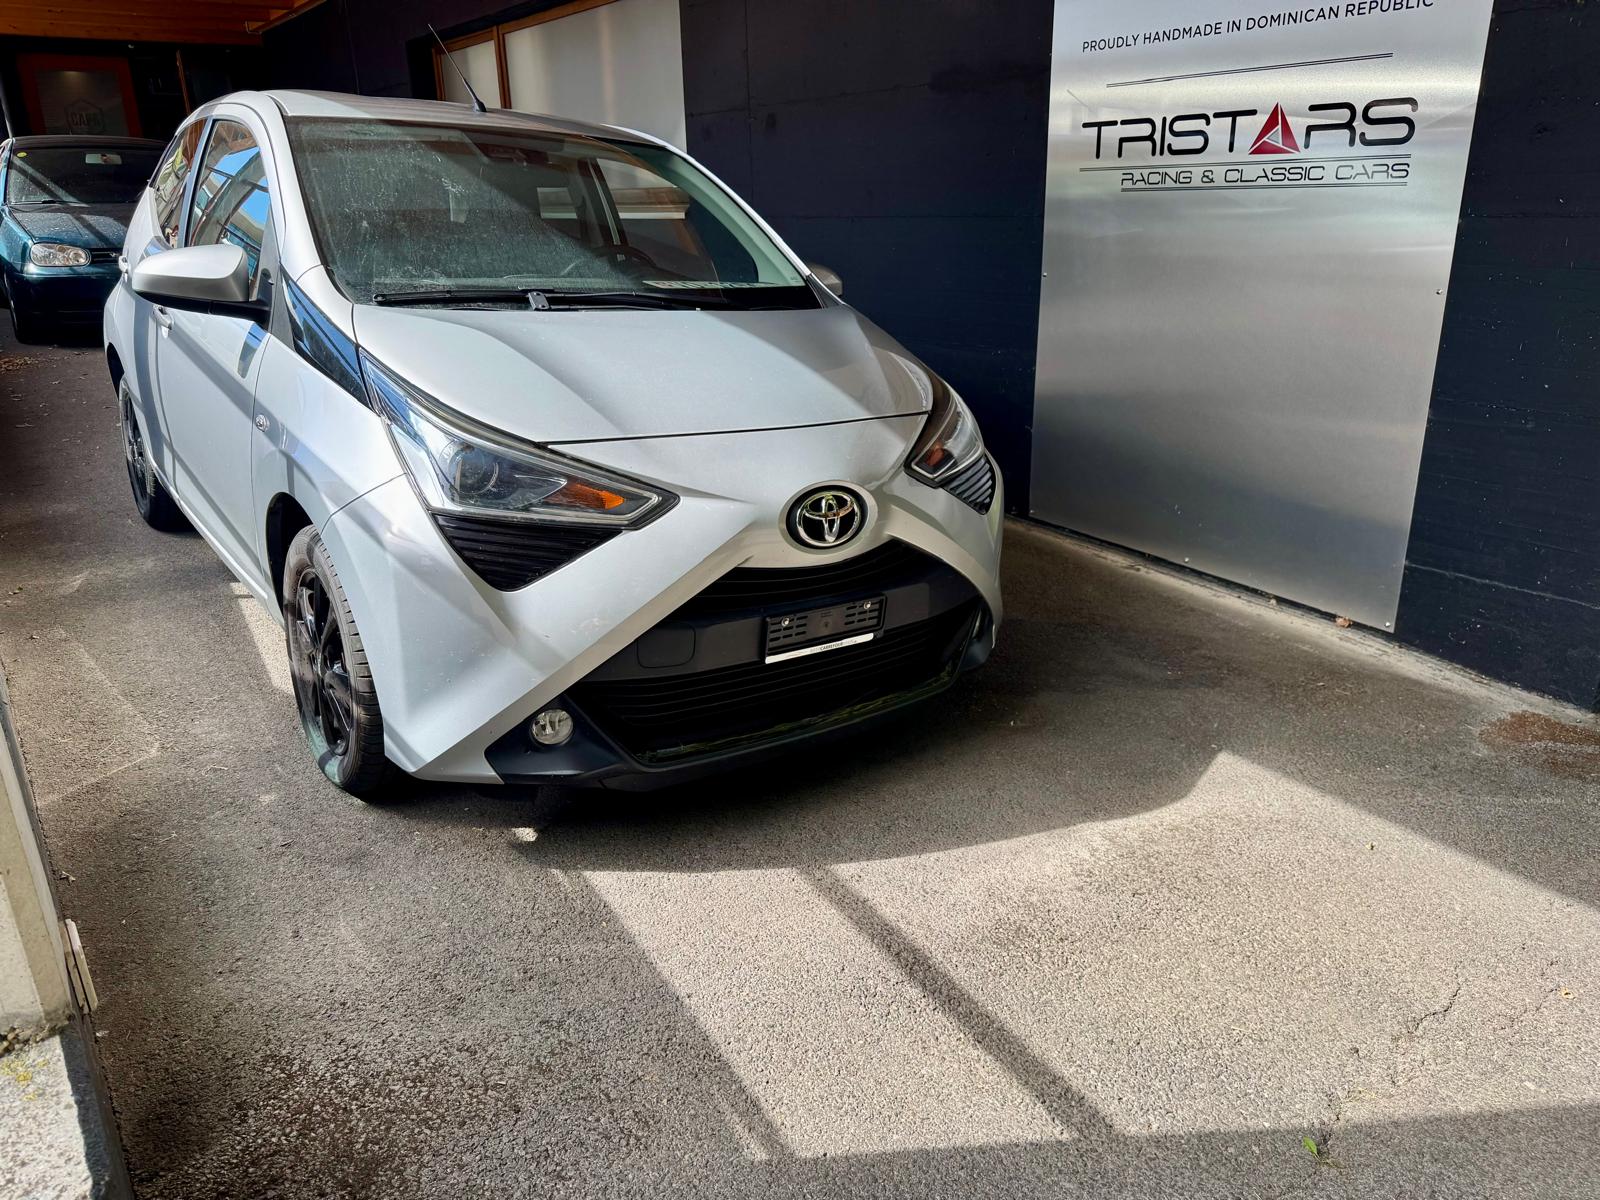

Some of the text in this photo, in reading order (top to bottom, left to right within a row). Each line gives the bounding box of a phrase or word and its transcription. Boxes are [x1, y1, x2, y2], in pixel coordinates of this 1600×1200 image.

[1082, 34, 1140, 53] PROUDLY
[1143, 22, 1222, 45] HANDMADE
[1226, 19, 1242, 33] IN
[1246, 5, 1340, 30] DOMINICAN
[1082, 97, 1419, 160] TRISTARS
[1120, 162, 1411, 186] RACING & CLASSIC CARS
